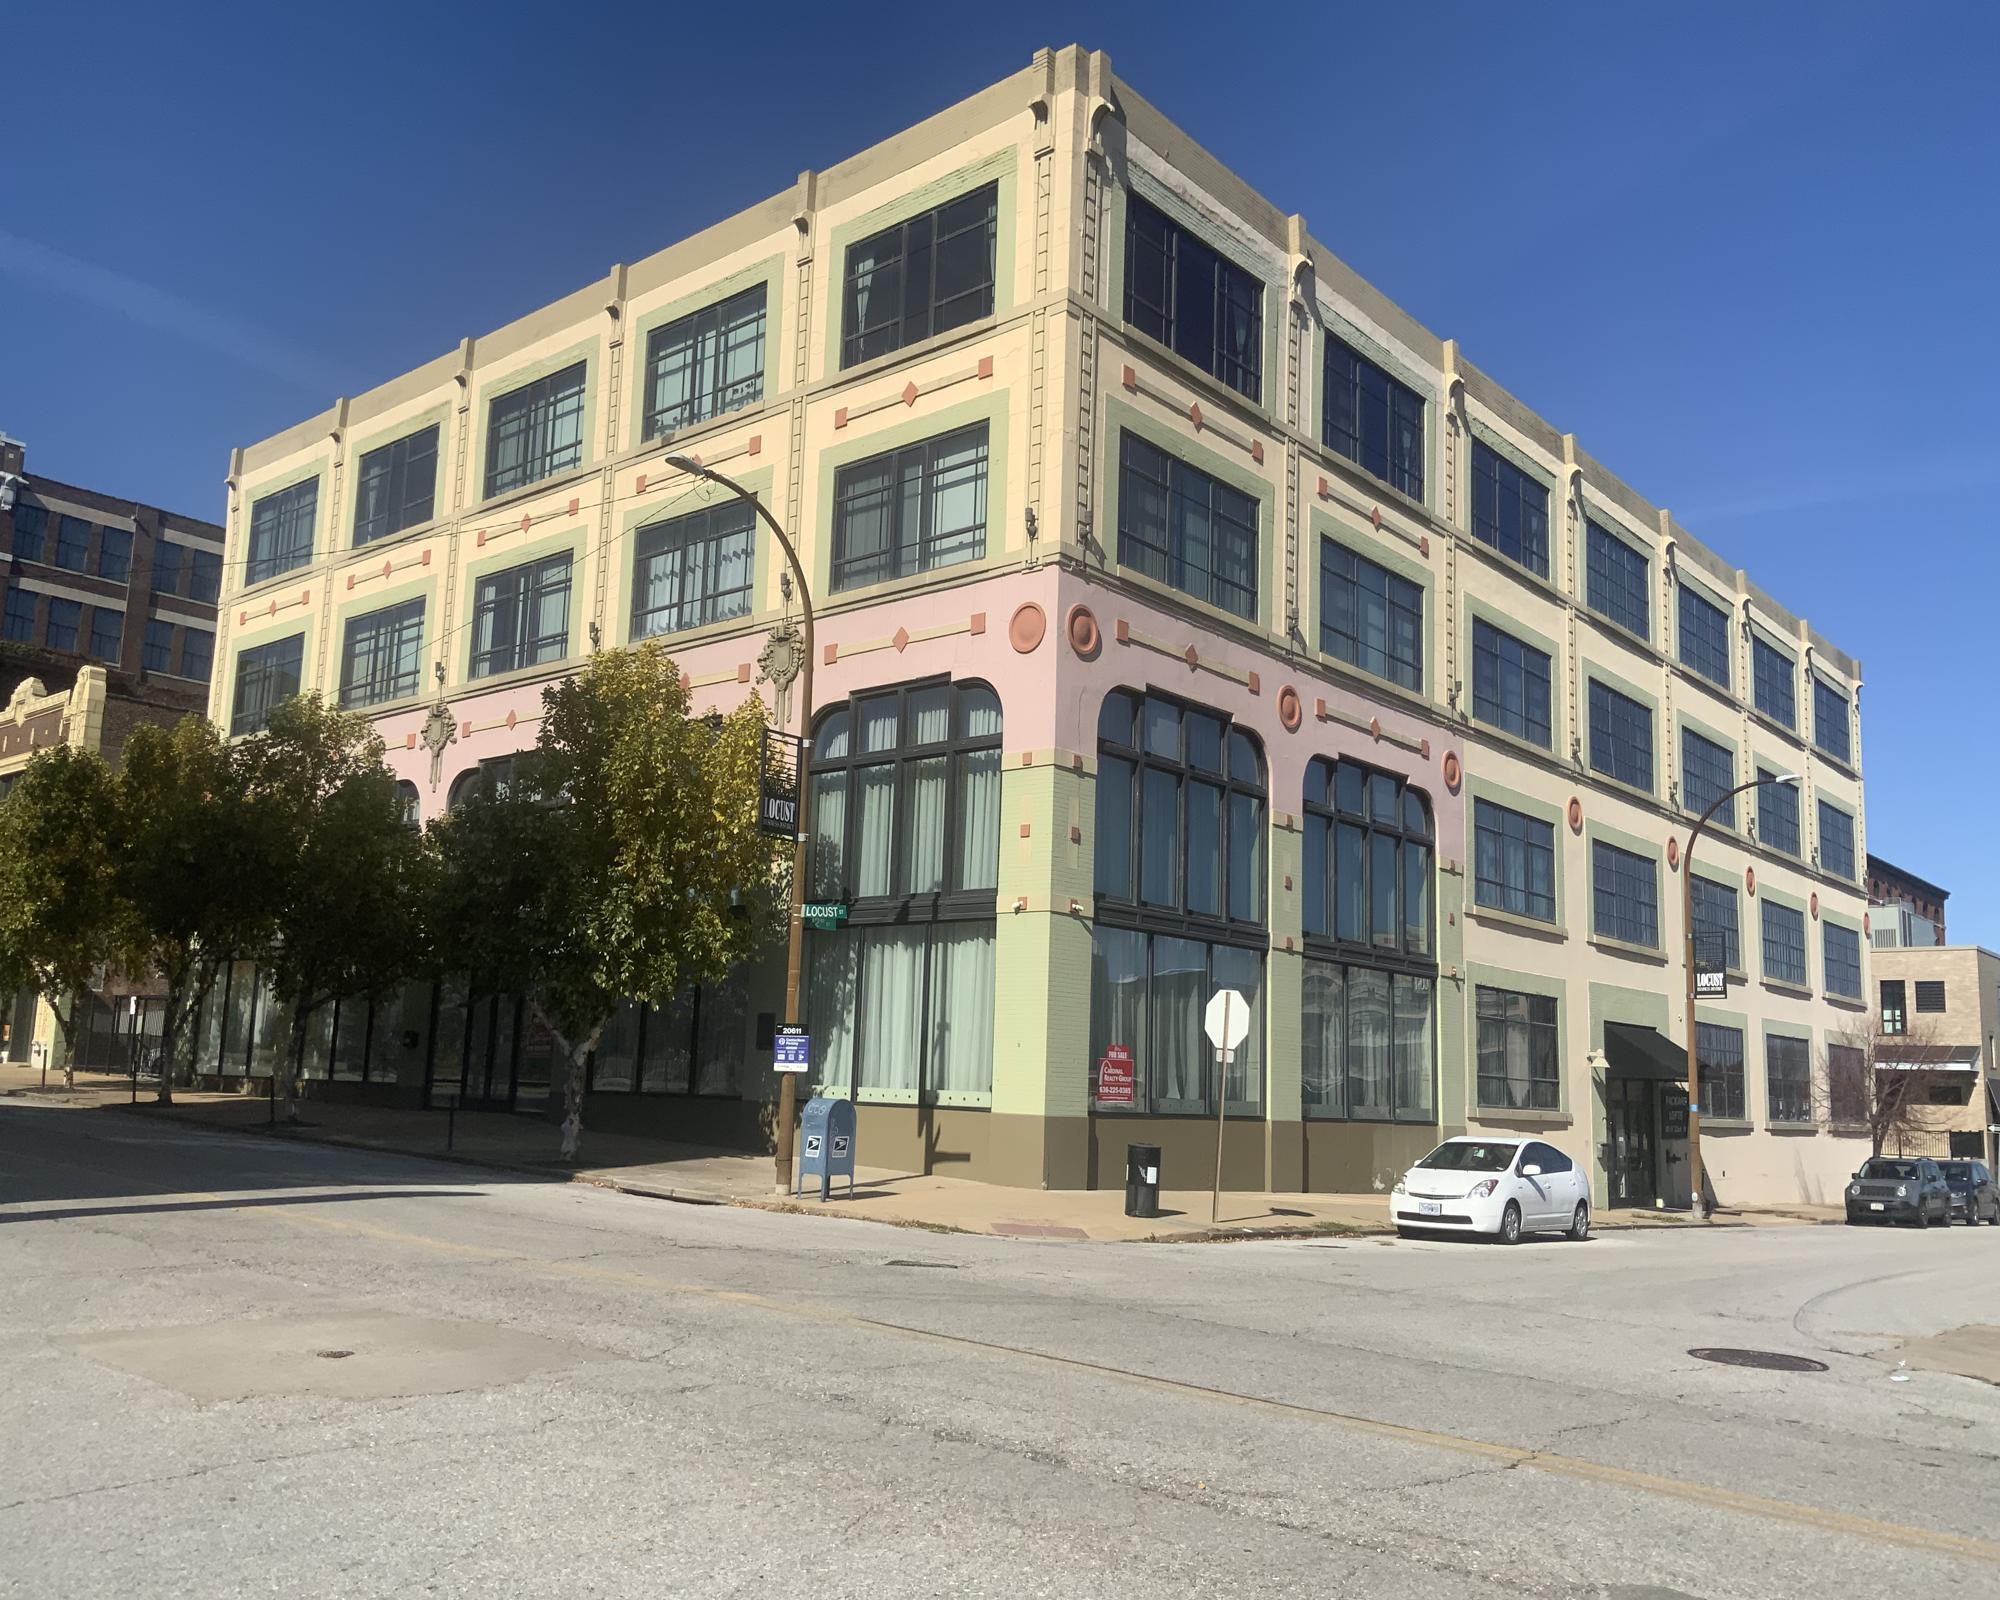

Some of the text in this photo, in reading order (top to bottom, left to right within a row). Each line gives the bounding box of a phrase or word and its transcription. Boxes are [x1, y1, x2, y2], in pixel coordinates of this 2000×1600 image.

[764, 797, 795, 823] LOCUST
[806, 906, 838, 917] LOCUST
[1697, 973, 1723, 986] LOCUST
